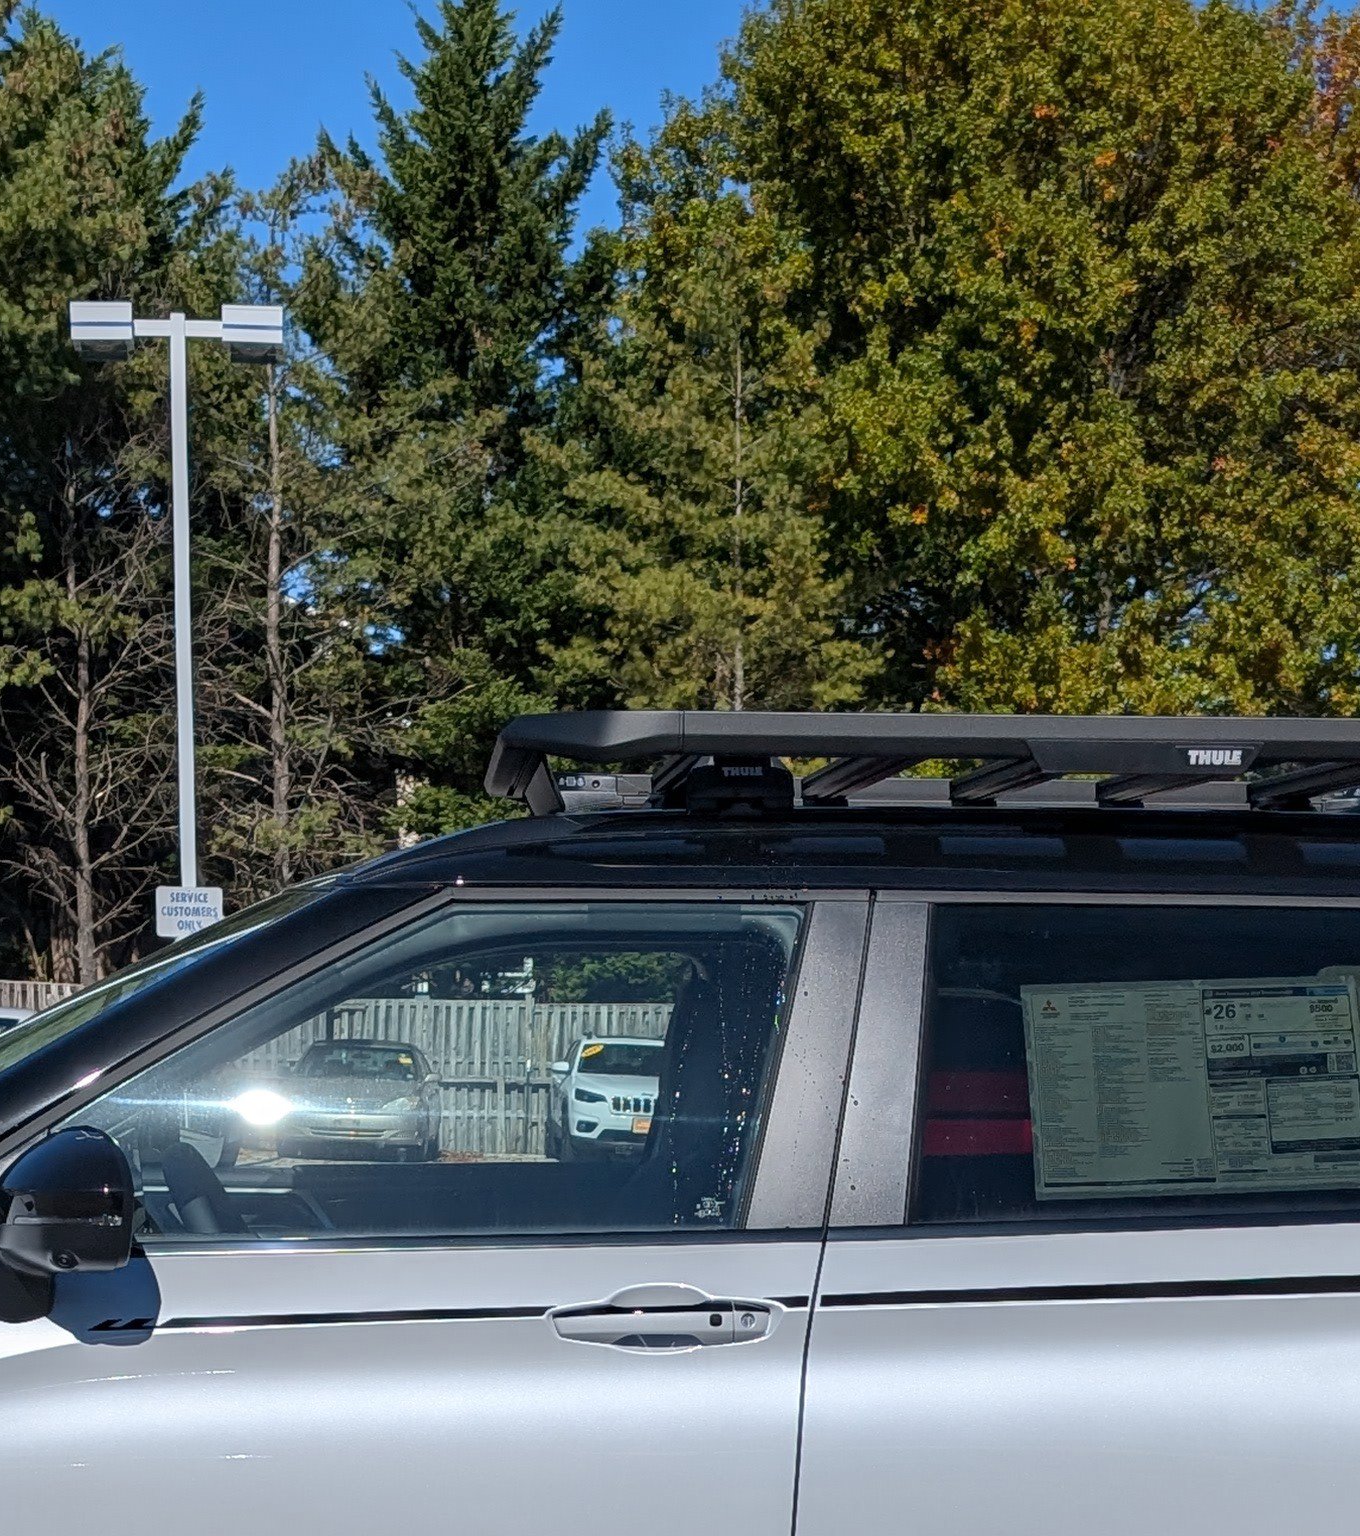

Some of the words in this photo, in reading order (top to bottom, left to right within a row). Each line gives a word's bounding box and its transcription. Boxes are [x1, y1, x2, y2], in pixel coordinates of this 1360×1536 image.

[1187, 749, 1242, 766] THULE
[170, 892, 209, 903] SERVICE
[161, 906, 219, 919] CUSTOMERS
[177, 920, 203, 931] ONLY
[1213, 1003, 1237, 1020] 26
